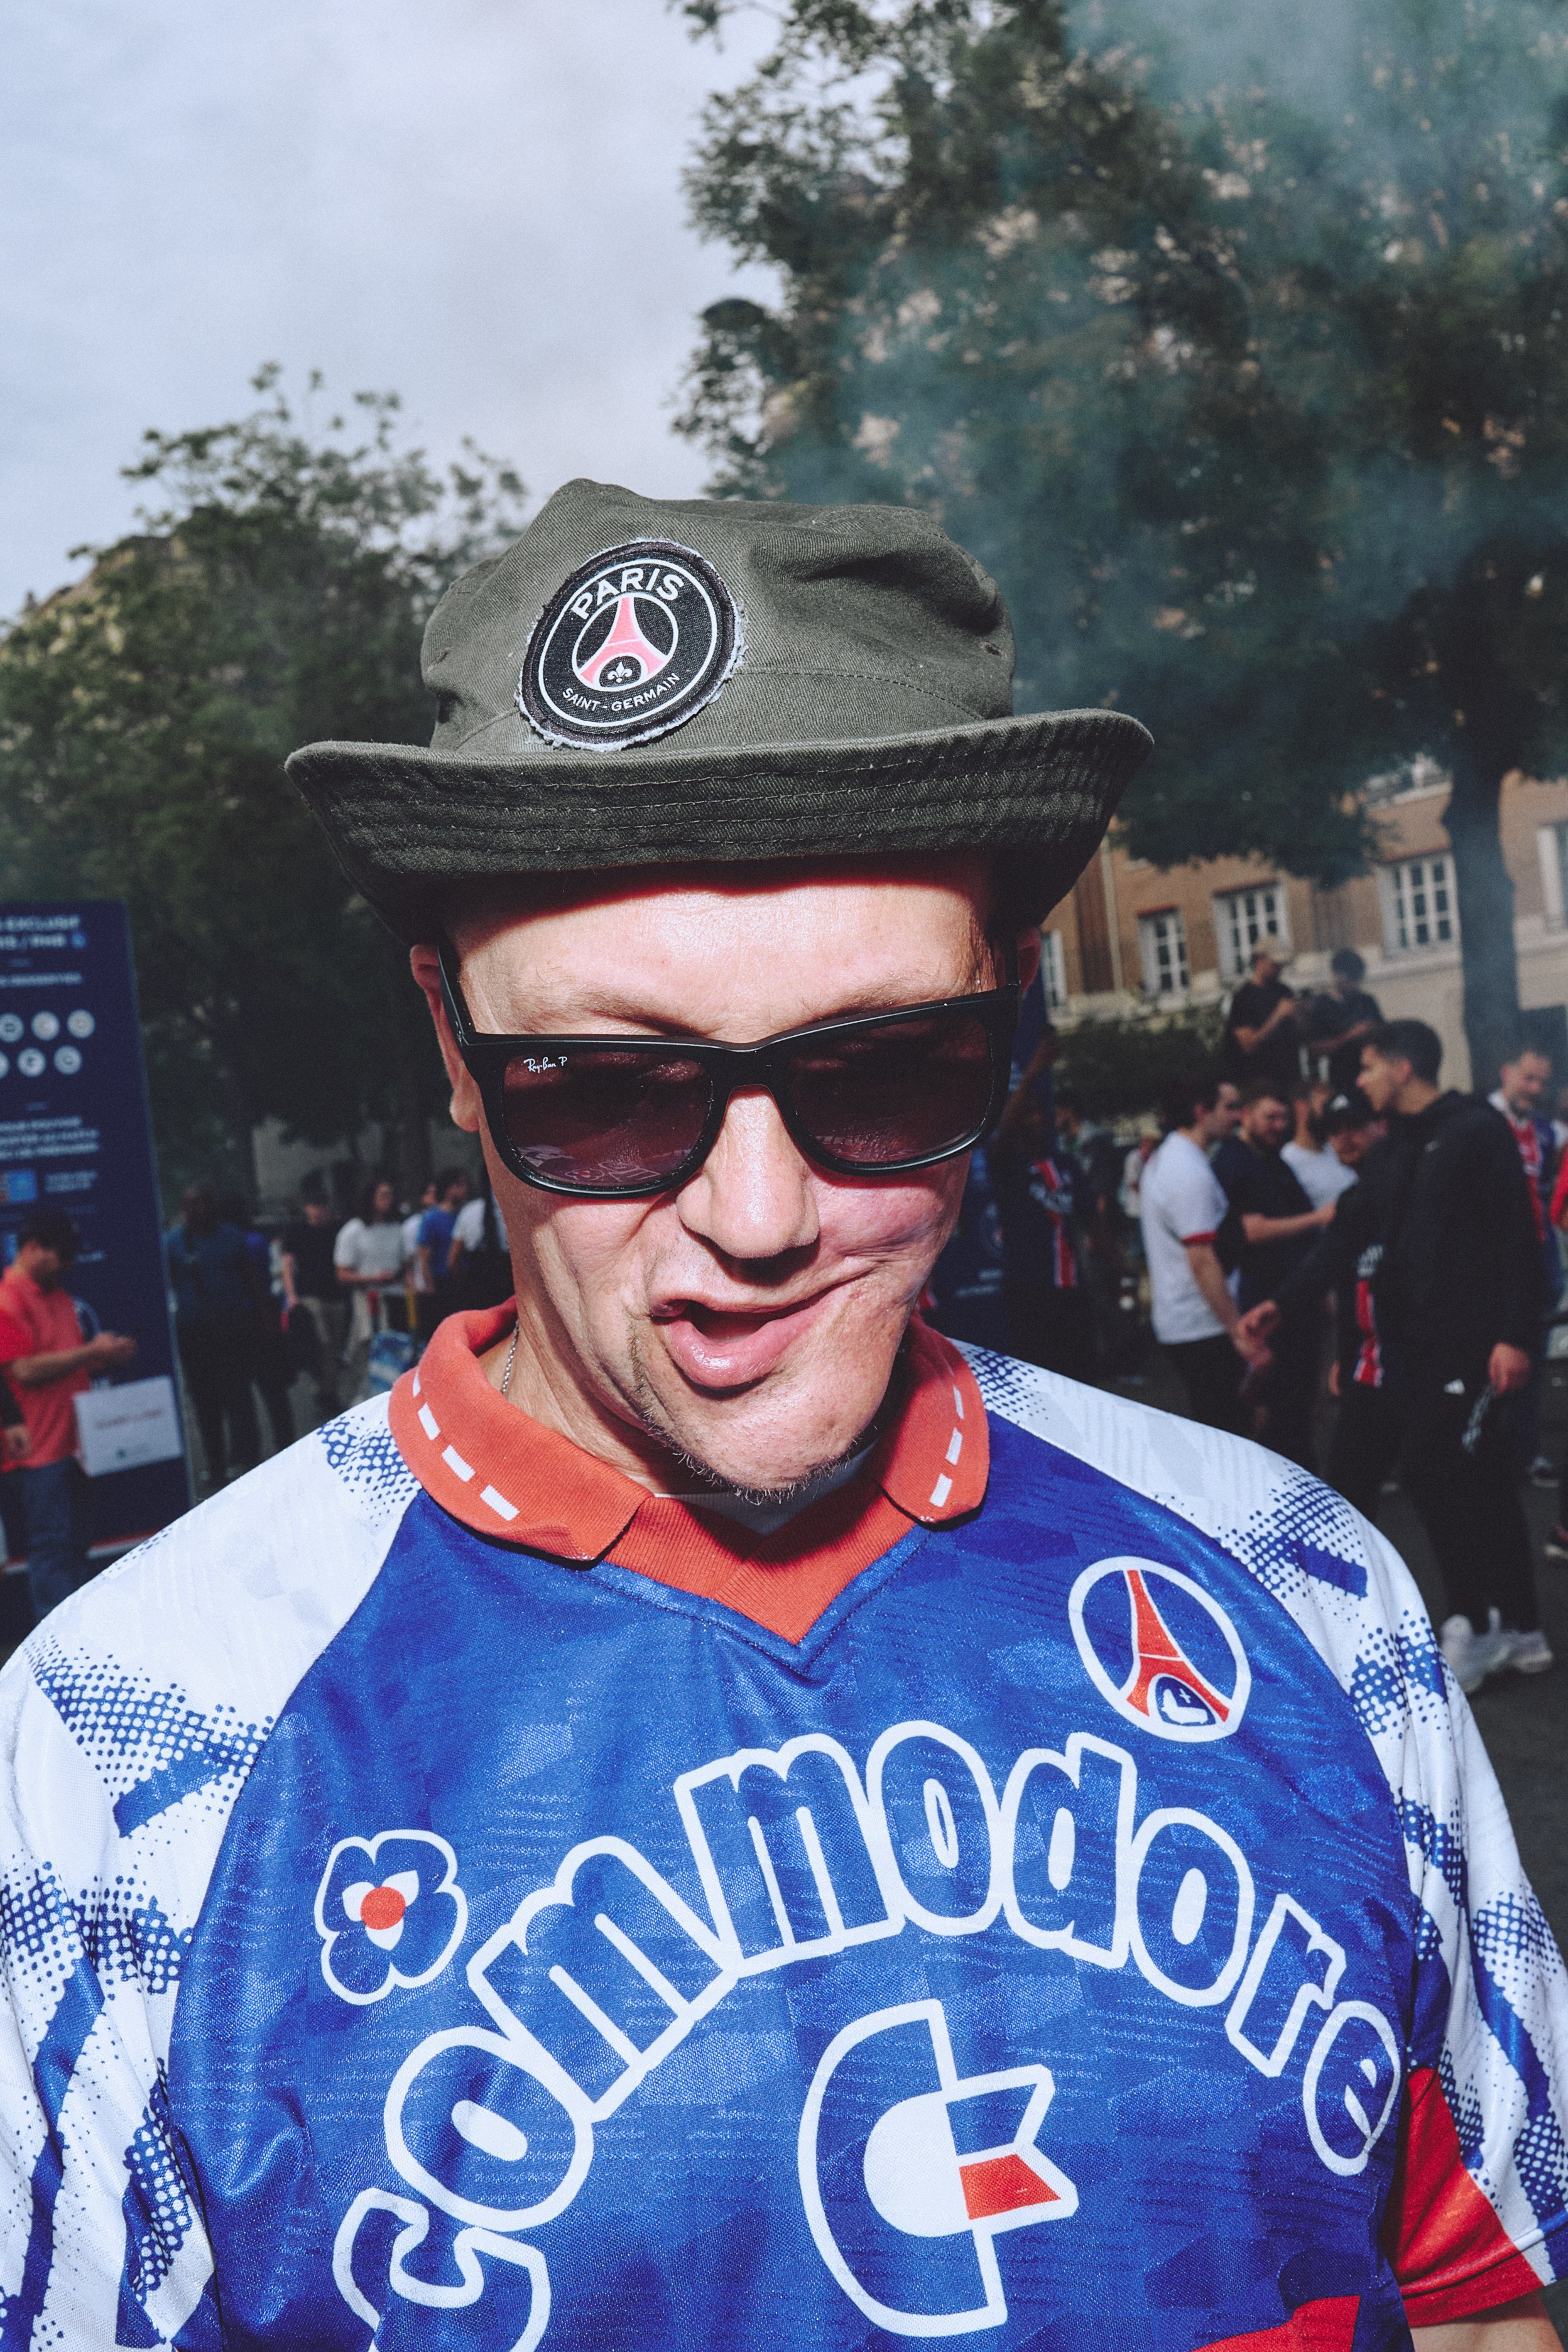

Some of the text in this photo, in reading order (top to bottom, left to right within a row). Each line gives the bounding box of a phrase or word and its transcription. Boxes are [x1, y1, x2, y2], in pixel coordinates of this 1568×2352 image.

[570, 567, 685, 620] PARIS
[562, 672, 680, 712] SAINT-GERMAIN
[558, 1056, 568, 1066] P
